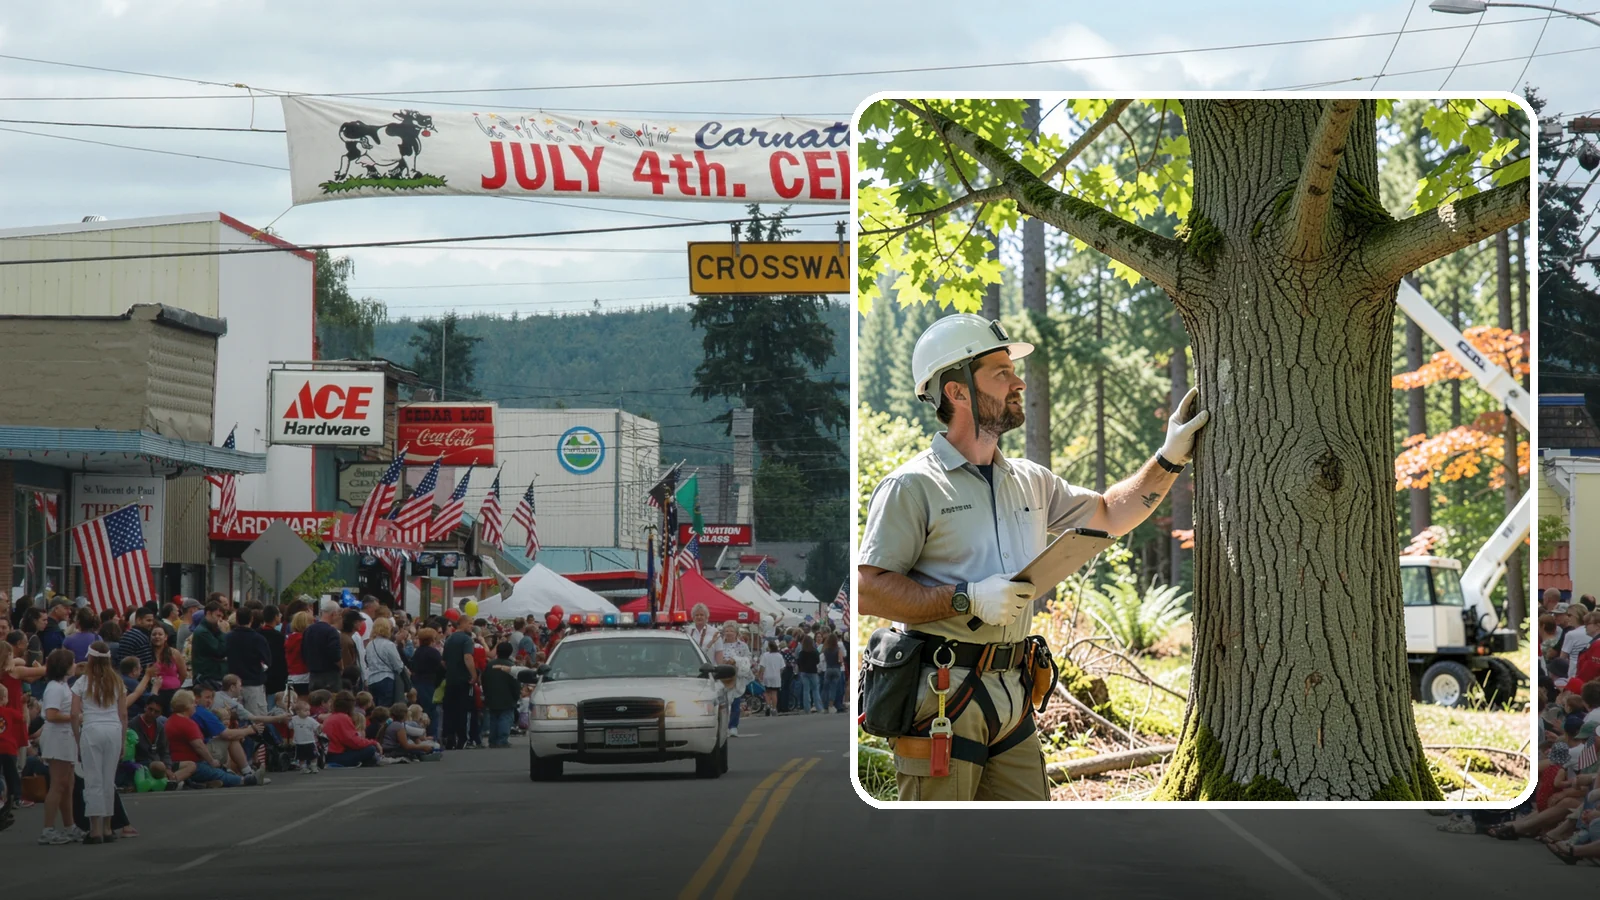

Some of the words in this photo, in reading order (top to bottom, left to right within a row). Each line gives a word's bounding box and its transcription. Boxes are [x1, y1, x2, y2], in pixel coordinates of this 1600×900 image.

[695, 121, 850, 149] Carnat
[481, 140, 604, 192] JULY
[632, 150, 746, 198] 4th.
[697, 254, 850, 280] CROSSWA
[282, 380, 374, 420] ACE
[405, 409, 453, 422] CEDAR
[461, 409, 485, 422] LOG
[283, 421, 371, 437] Hardware
[416, 428, 477, 447] Coca-Cola
[83, 484, 94, 494] St.
[95, 485, 124, 495] Vincent
[126, 486, 135, 495] de
[138, 486, 155, 495] Paul
[81, 503, 154, 522] THT
[688, 526, 741, 535] CRNATION
[699, 535, 730, 543] GLASS
